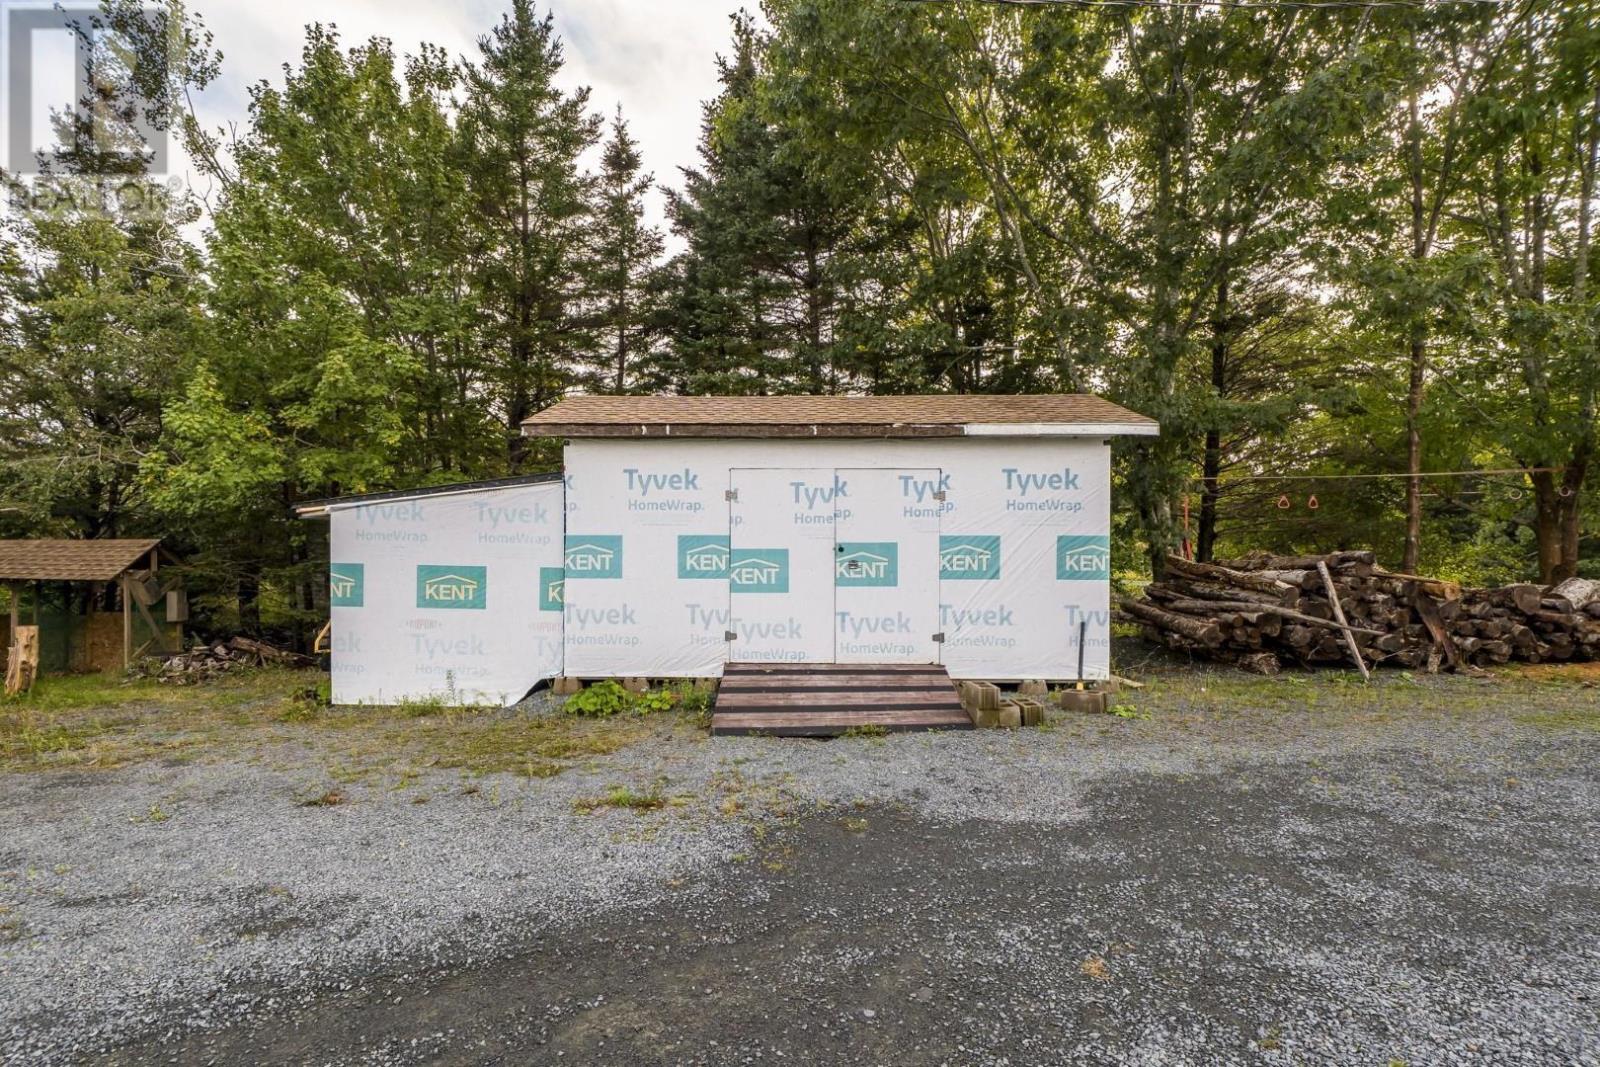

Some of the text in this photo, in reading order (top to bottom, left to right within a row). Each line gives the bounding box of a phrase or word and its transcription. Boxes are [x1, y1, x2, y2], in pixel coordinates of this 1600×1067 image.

[623, 468, 699, 496] Tyvek
[1001, 467, 1079, 496] Tyvek
[473, 501, 548, 528] Tyvek
[565, 554, 614, 571] KENT
[686, 554, 730, 571] KEN
[939, 554, 992, 571] KENT
[1065, 554, 1110, 571] KEN
[731, 568, 780, 584] KENT
[425, 584, 478, 600] KENT
[565, 603, 637, 630] Tyvek
[836, 611, 911, 640] Tyvek
[939, 604, 1014, 633] Tyvek
[731, 617, 802, 644] Tyvek
[410, 632, 485, 658] Tyvek
